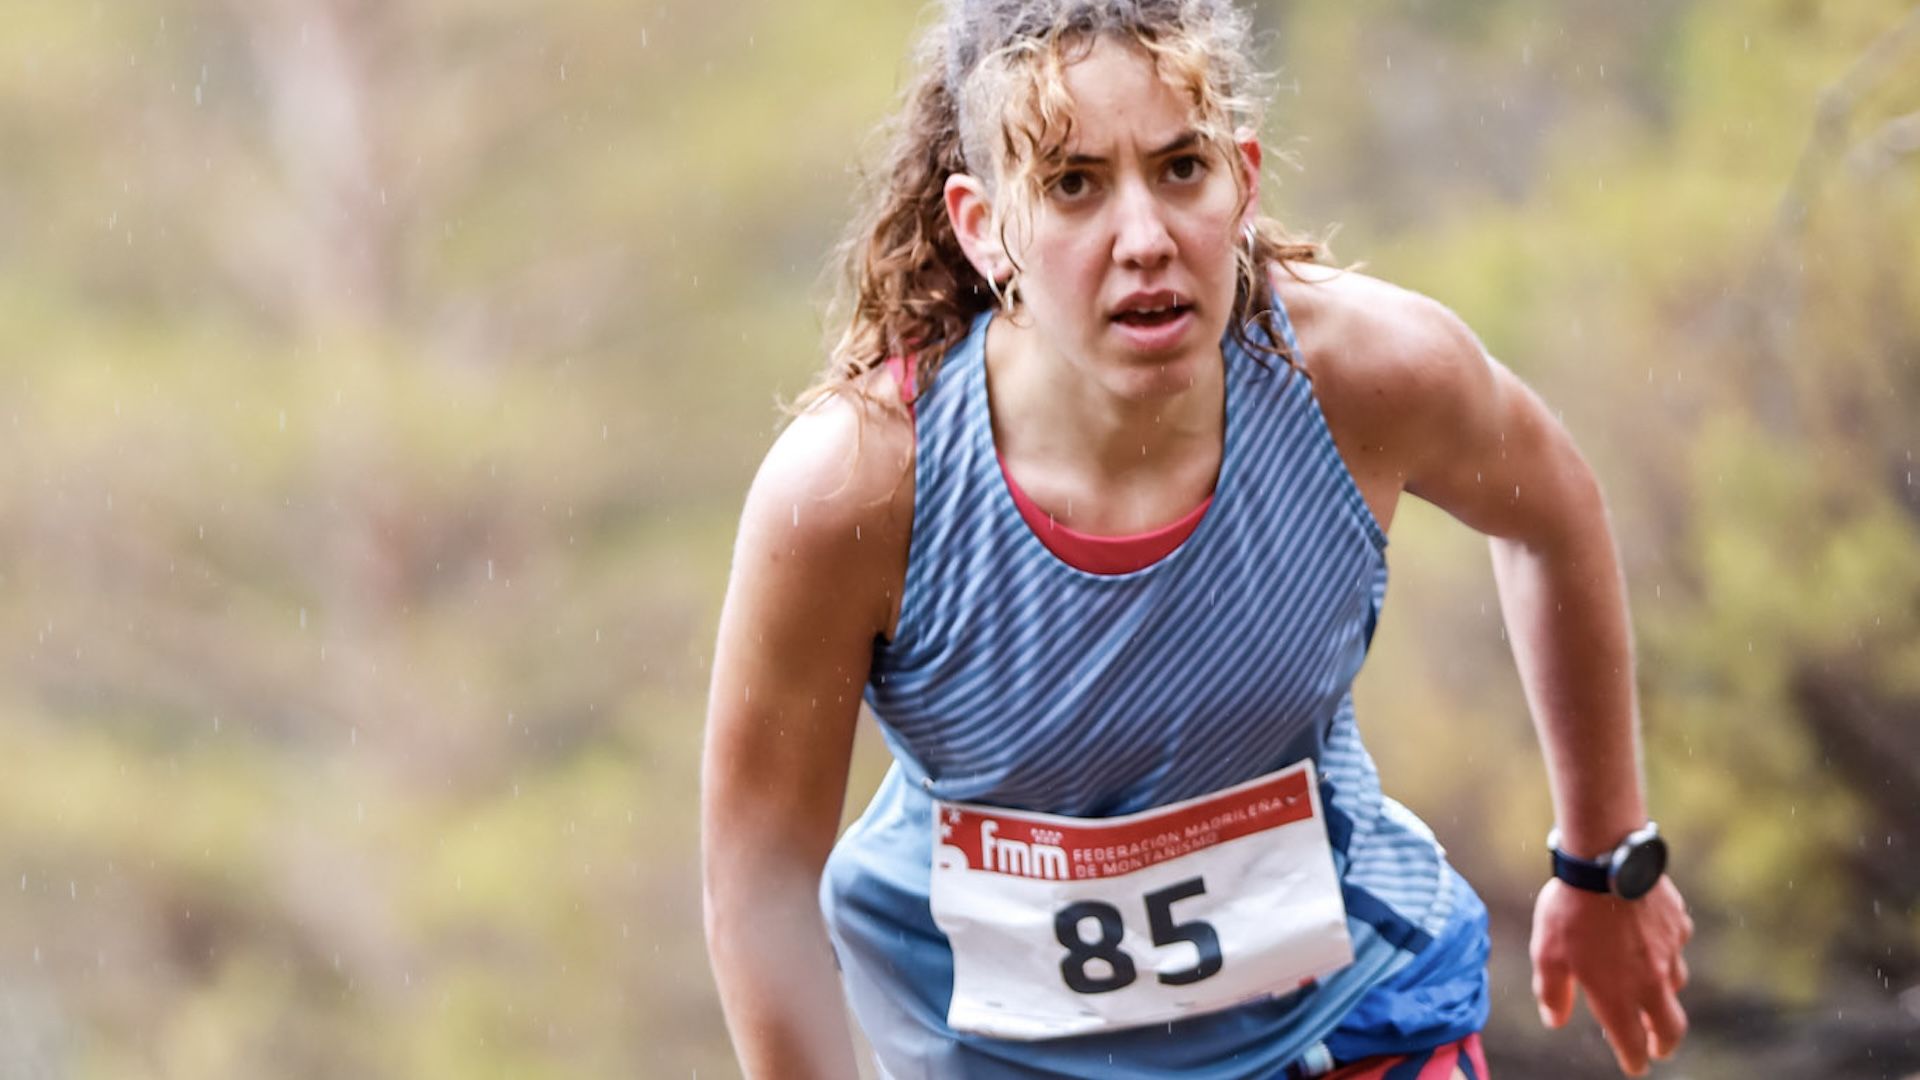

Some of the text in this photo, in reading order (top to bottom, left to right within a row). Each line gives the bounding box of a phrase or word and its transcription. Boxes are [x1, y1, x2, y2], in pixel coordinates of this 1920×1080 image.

[981, 820, 1070, 880] fmm
[1075, 863, 1097, 879] DE
[1055, 876, 1223, 994] 85
